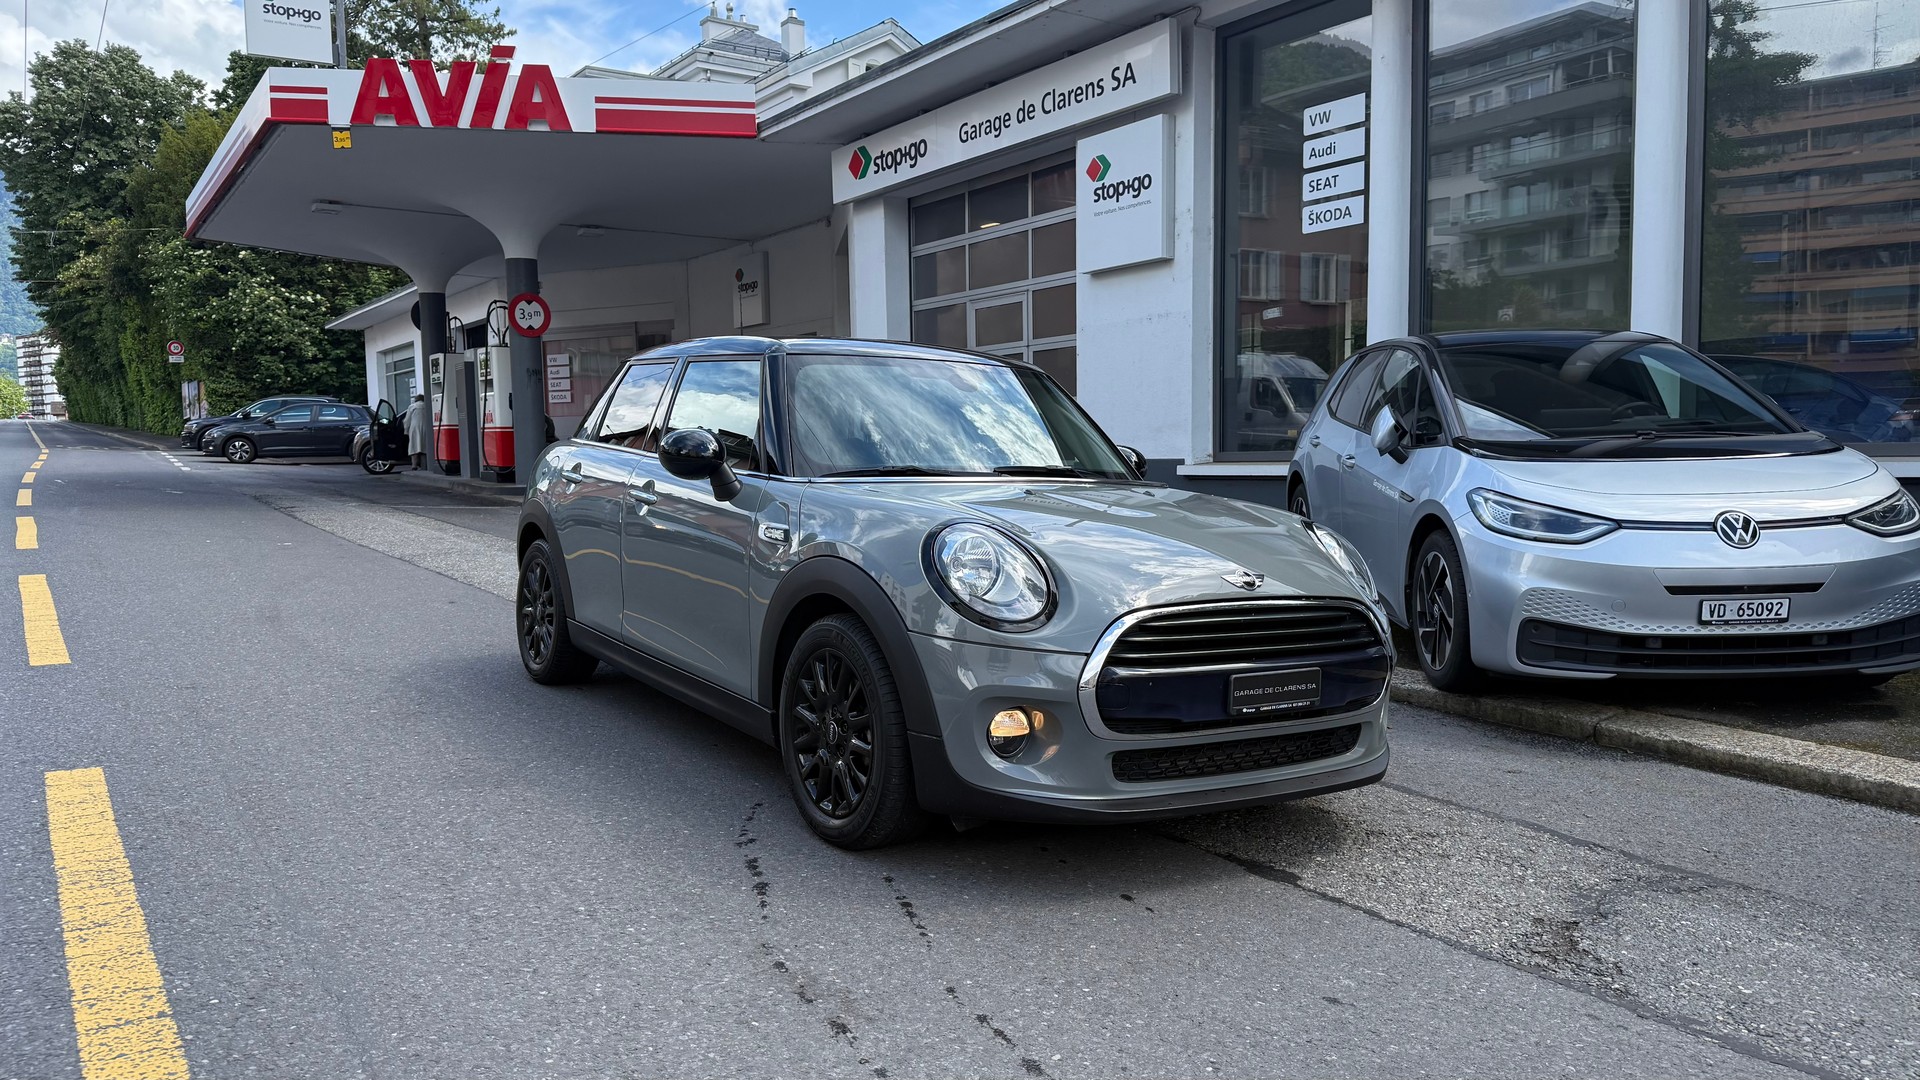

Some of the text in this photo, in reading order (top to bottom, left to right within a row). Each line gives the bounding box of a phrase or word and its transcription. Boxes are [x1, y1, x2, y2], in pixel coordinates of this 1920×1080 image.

[263, 3, 322, 22] stop+go
[959, 62, 1137, 144] Garage de Clarens SA
[1309, 109, 1332, 127] VW
[873, 138, 928, 175] stop+go
[1308, 141, 1337, 160] Audi
[1093, 173, 1152, 203] stop+go
[1308, 174, 1340, 193] SEAT
[1308, 205, 1353, 226] ŠKODA
[1709, 601, 1784, 618] VD 65092
[1234, 688, 1263, 697] GARAGE
[1274, 683, 1306, 693] CLARENS
